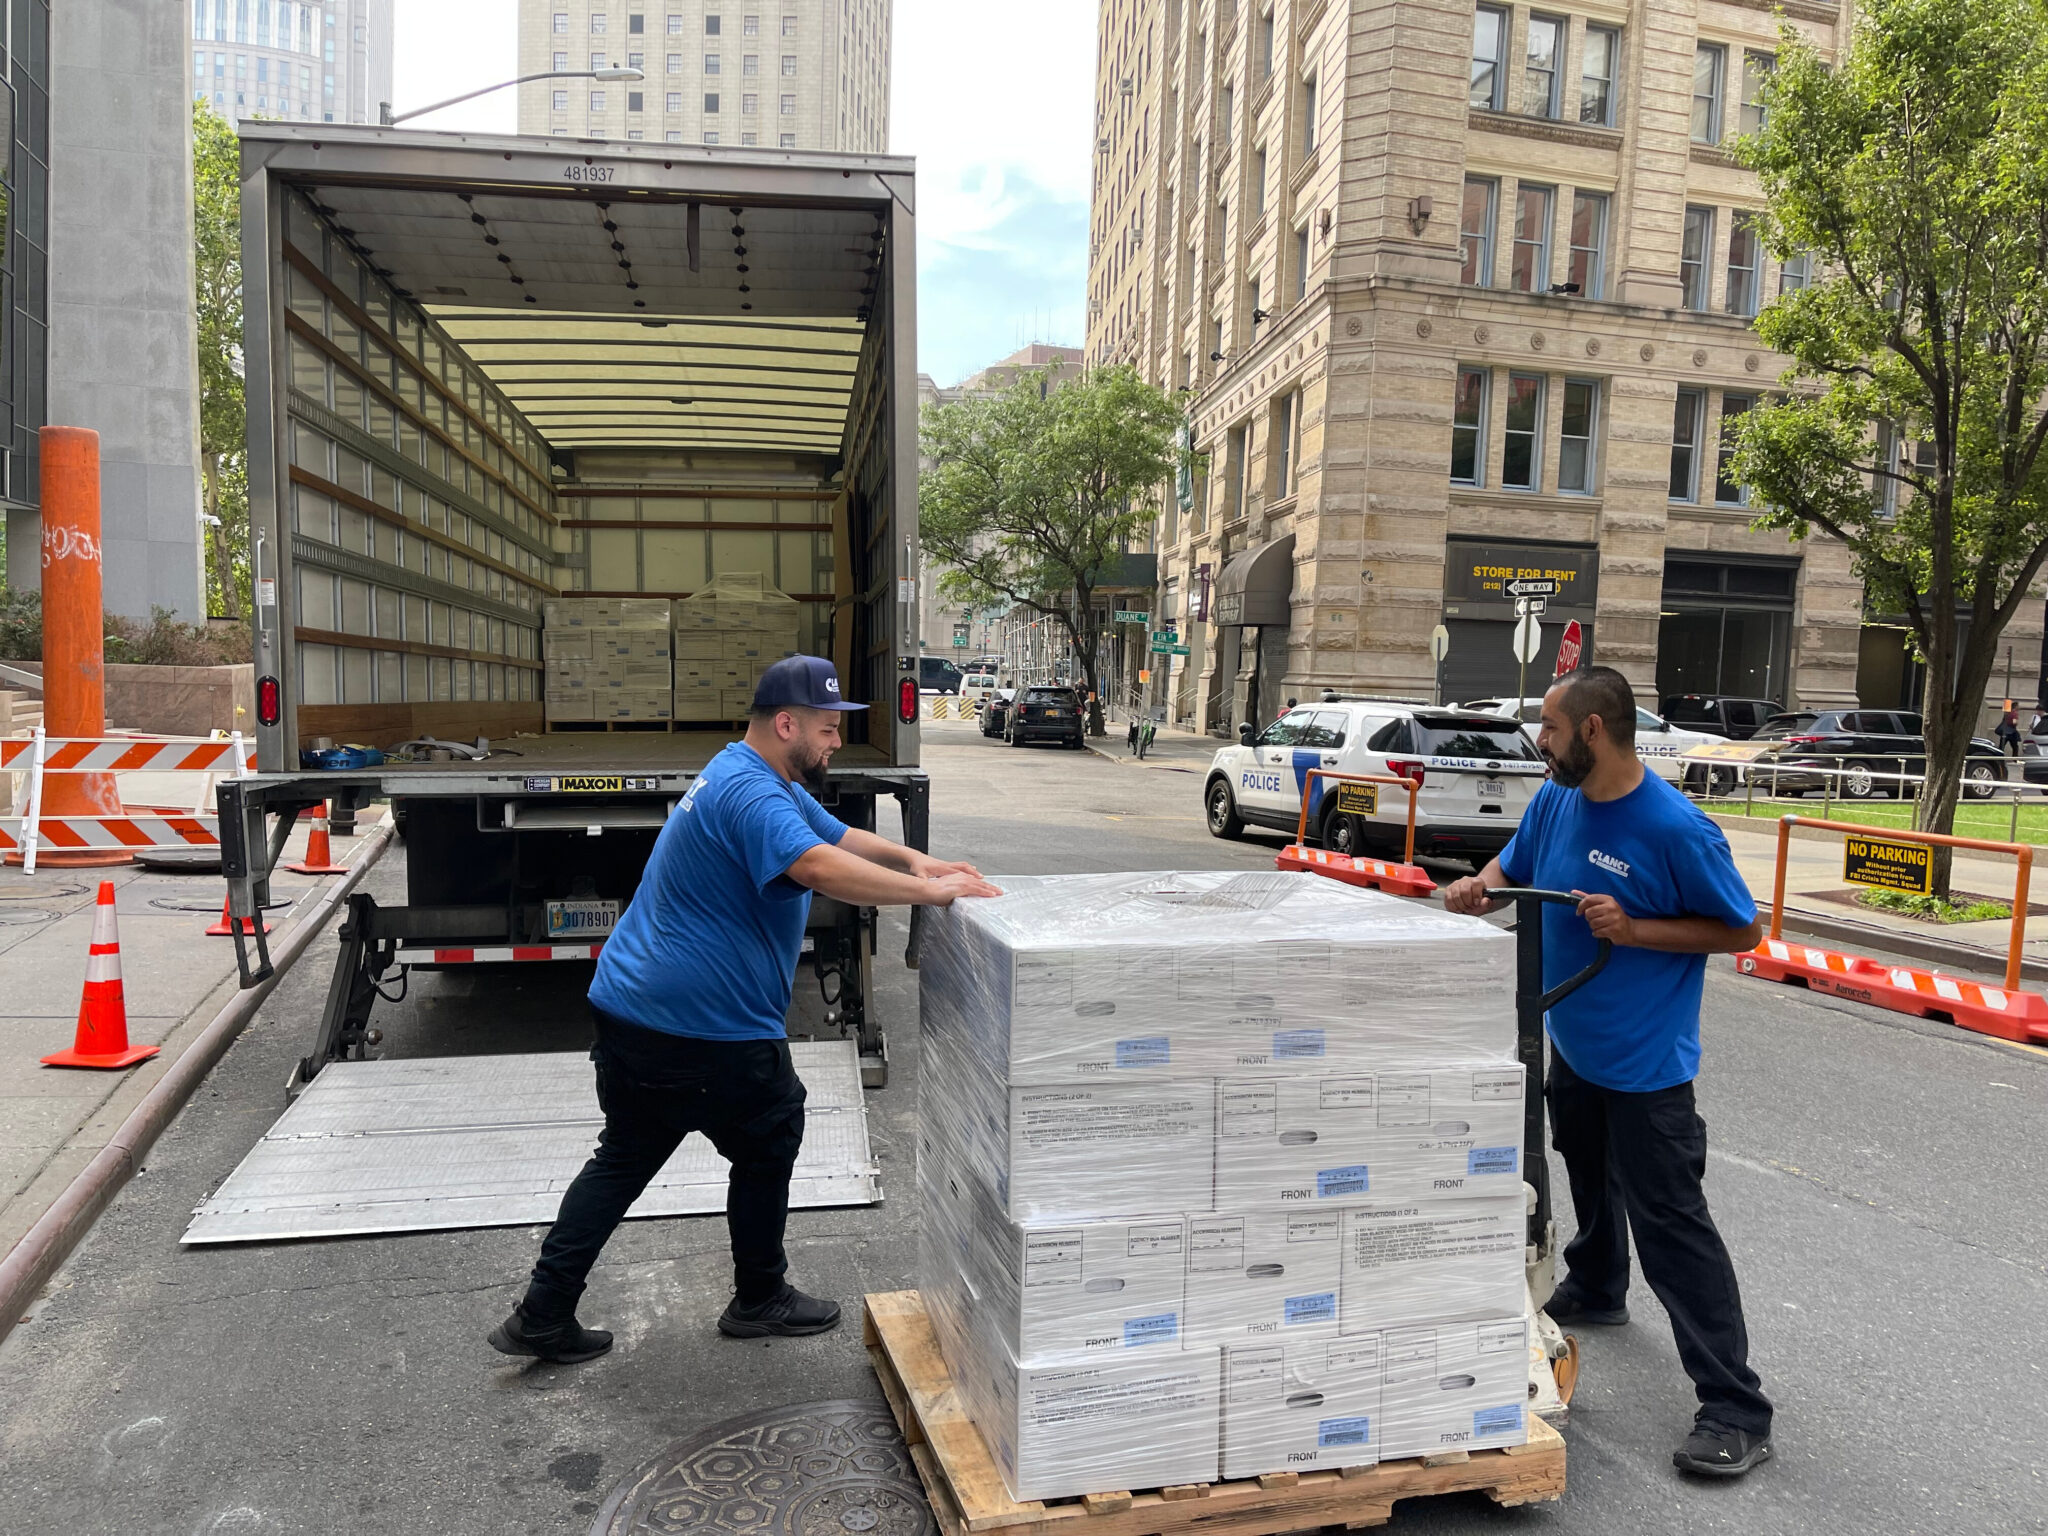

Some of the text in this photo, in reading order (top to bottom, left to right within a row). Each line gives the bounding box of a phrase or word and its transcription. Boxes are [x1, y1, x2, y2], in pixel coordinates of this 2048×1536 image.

[564, 166, 615, 182] 481937
[1473, 566, 1576, 581] STORE FOR RENT
[1483, 581, 1501, 590] (212)
[1513, 584, 1529, 592] ONE
[1533, 583, 1550, 591] WAY
[1116, 612, 1139, 620] DUANE
[1560, 640, 1580, 667] STOP
[1432, 758, 1477, 768] POLICE
[564, 778, 618, 790] MAXON
[1242, 773, 1280, 792] POLICE
[1341, 785, 1375, 797] NO PARKING
[1849, 842, 1926, 866] NO PARKING
[1588, 849, 1630, 872] CLANCY
[1866, 861, 1906, 873] Without prior
[1857, 868, 1898, 879] authorization
[1861, 874, 1880, 882] Crisis
[1901, 881, 1921, 889] Squad
[565, 911, 616, 928] 3078907
[1237, 1056, 1268, 1065] FRONT
[1077, 1063, 1110, 1072] FRONT
[1433, 1179, 1464, 1189] FRONT
[1281, 1189, 1312, 1200] FRONT
[1355, 1210, 1397, 1219] INSTRUCTIONS
[1247, 1322, 1278, 1332] FRONT
[1085, 1337, 1118, 1348] FRONT
[1440, 1432, 1470, 1443] FRONT
[1287, 1451, 1318, 1462] FRONT
